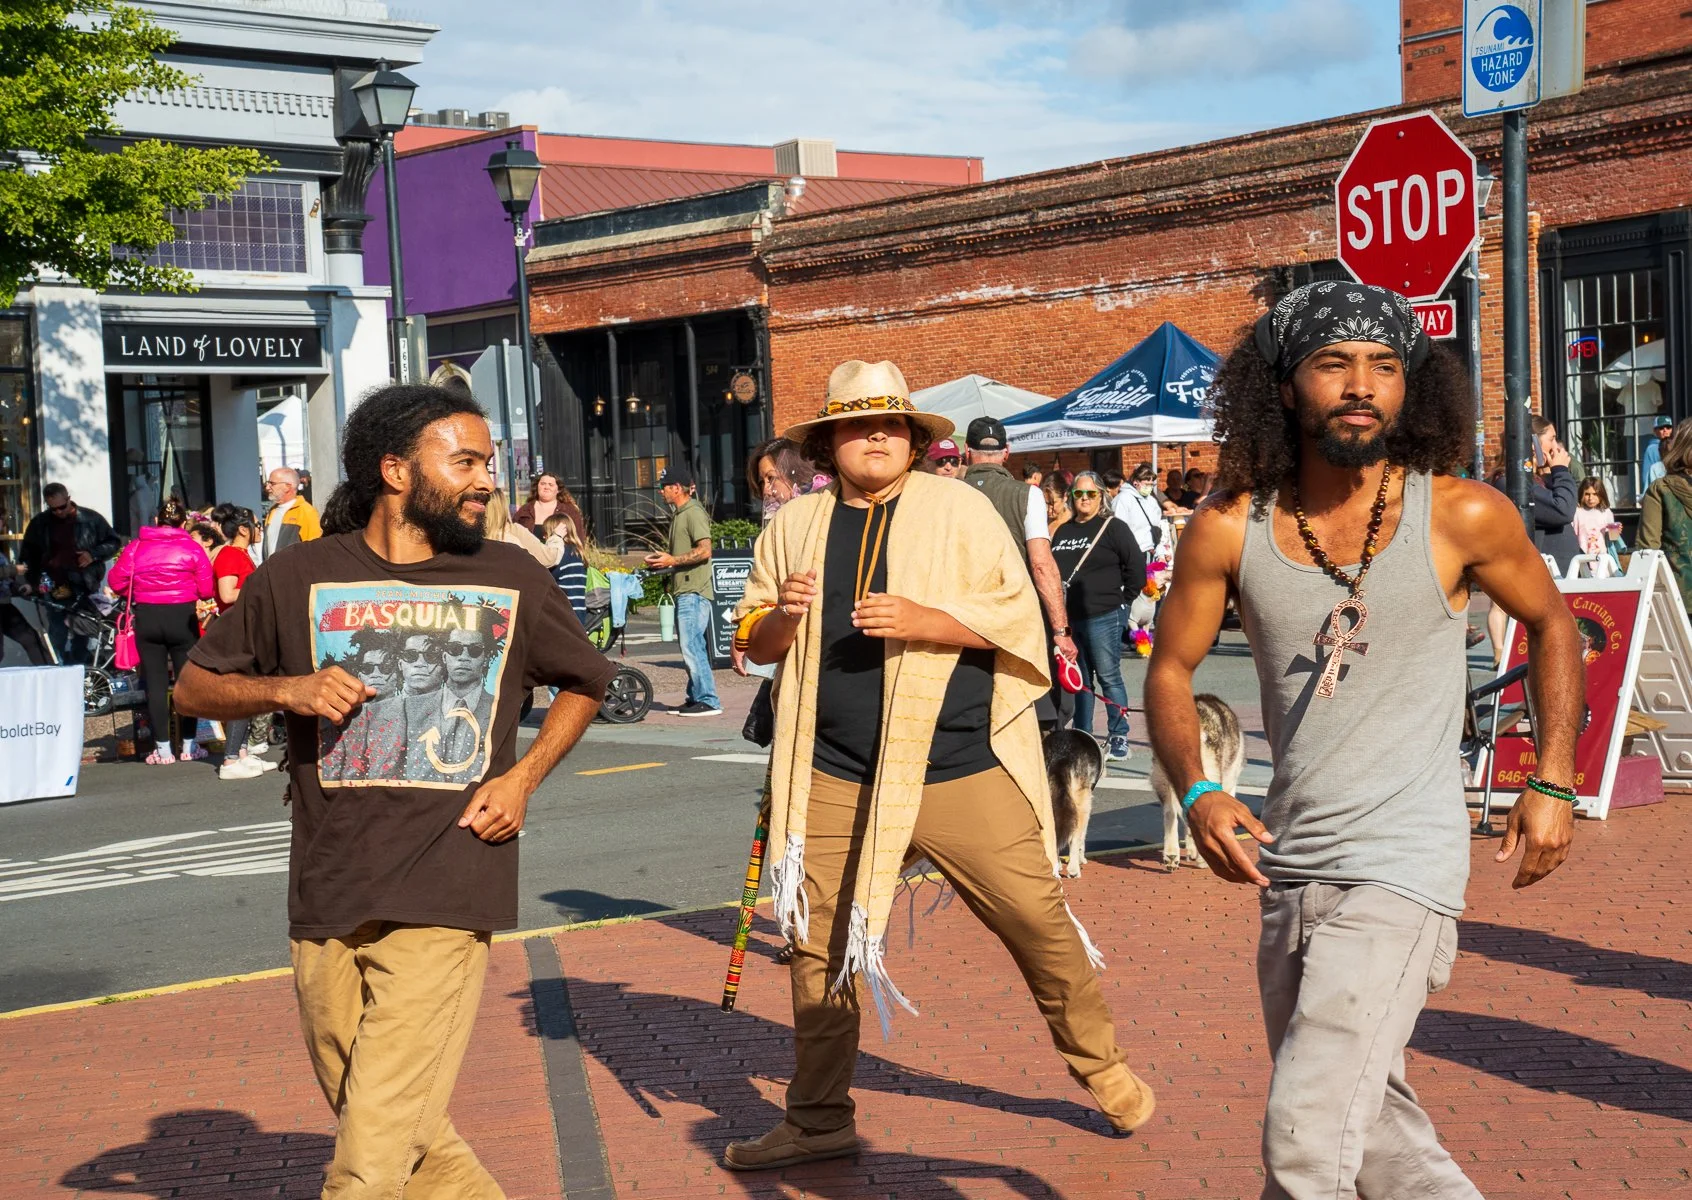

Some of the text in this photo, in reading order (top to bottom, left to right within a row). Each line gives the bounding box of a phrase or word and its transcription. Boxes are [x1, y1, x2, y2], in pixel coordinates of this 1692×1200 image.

[1475, 42, 1505, 56] TSUNAMI
[1481, 51, 1523, 72] HAZARD
[1488, 68, 1516, 87] ZONE
[1346, 168, 1466, 250] STOP
[121, 334, 303, 361] LAND of LOVELY
[1066, 383, 1156, 410] Familia
[1046, 429, 1075, 439] ROASTED
[344, 601, 481, 631] BASQUIAT
[1572, 596, 1622, 655] Carriage Co.
